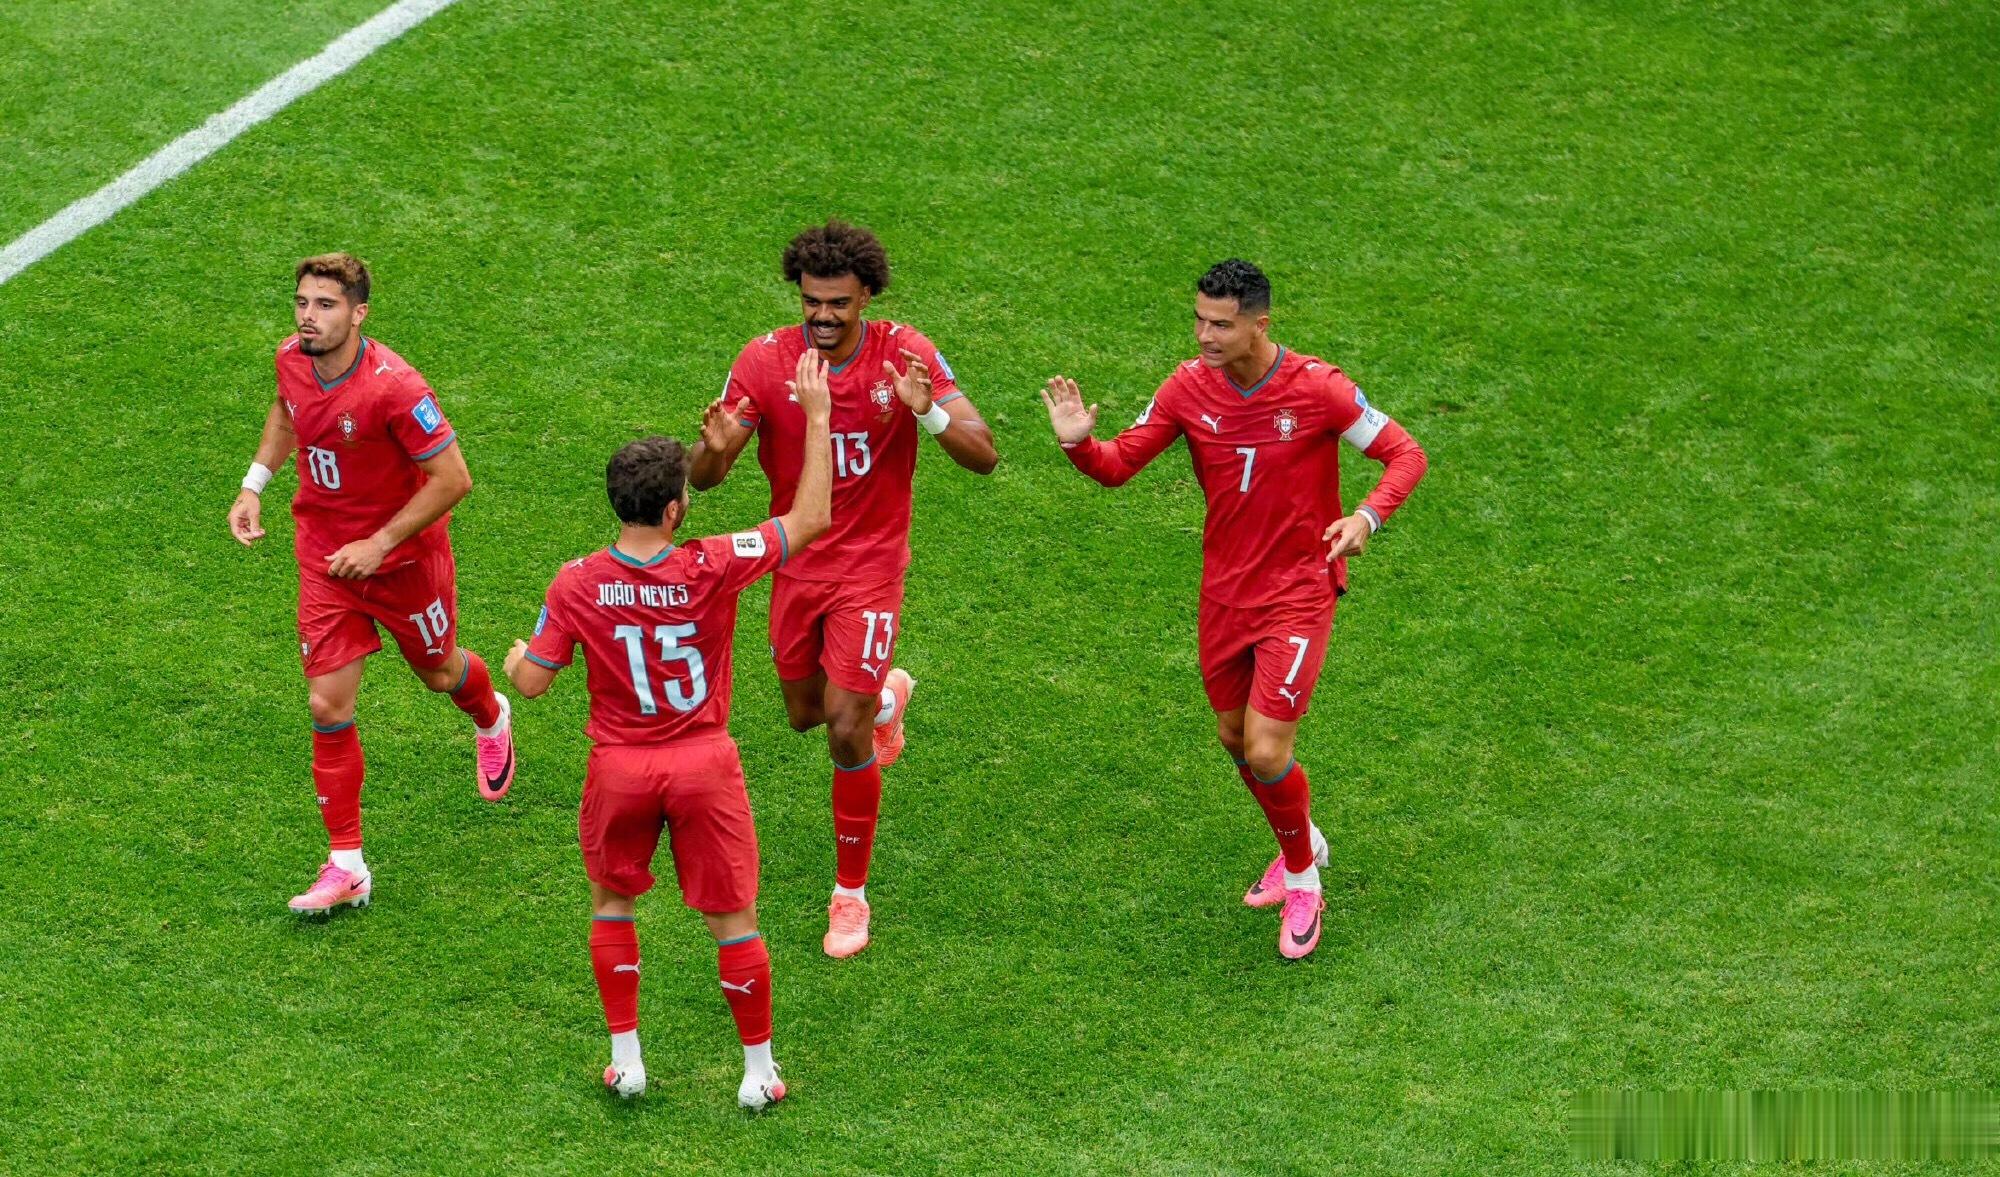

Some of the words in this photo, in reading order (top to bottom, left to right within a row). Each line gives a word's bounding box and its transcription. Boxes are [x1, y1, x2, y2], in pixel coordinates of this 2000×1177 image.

[307, 445, 341, 491] 18
[830, 431, 872, 477] 13
[1235, 446, 1257, 494] 7
[596, 580, 636, 607] JOÃO
[639, 583, 689, 606] NEVES
[409, 597, 449, 648] 18
[861, 610, 894, 660] 13
[613, 621, 708, 717] 15
[1284, 636, 1310, 686] 7
